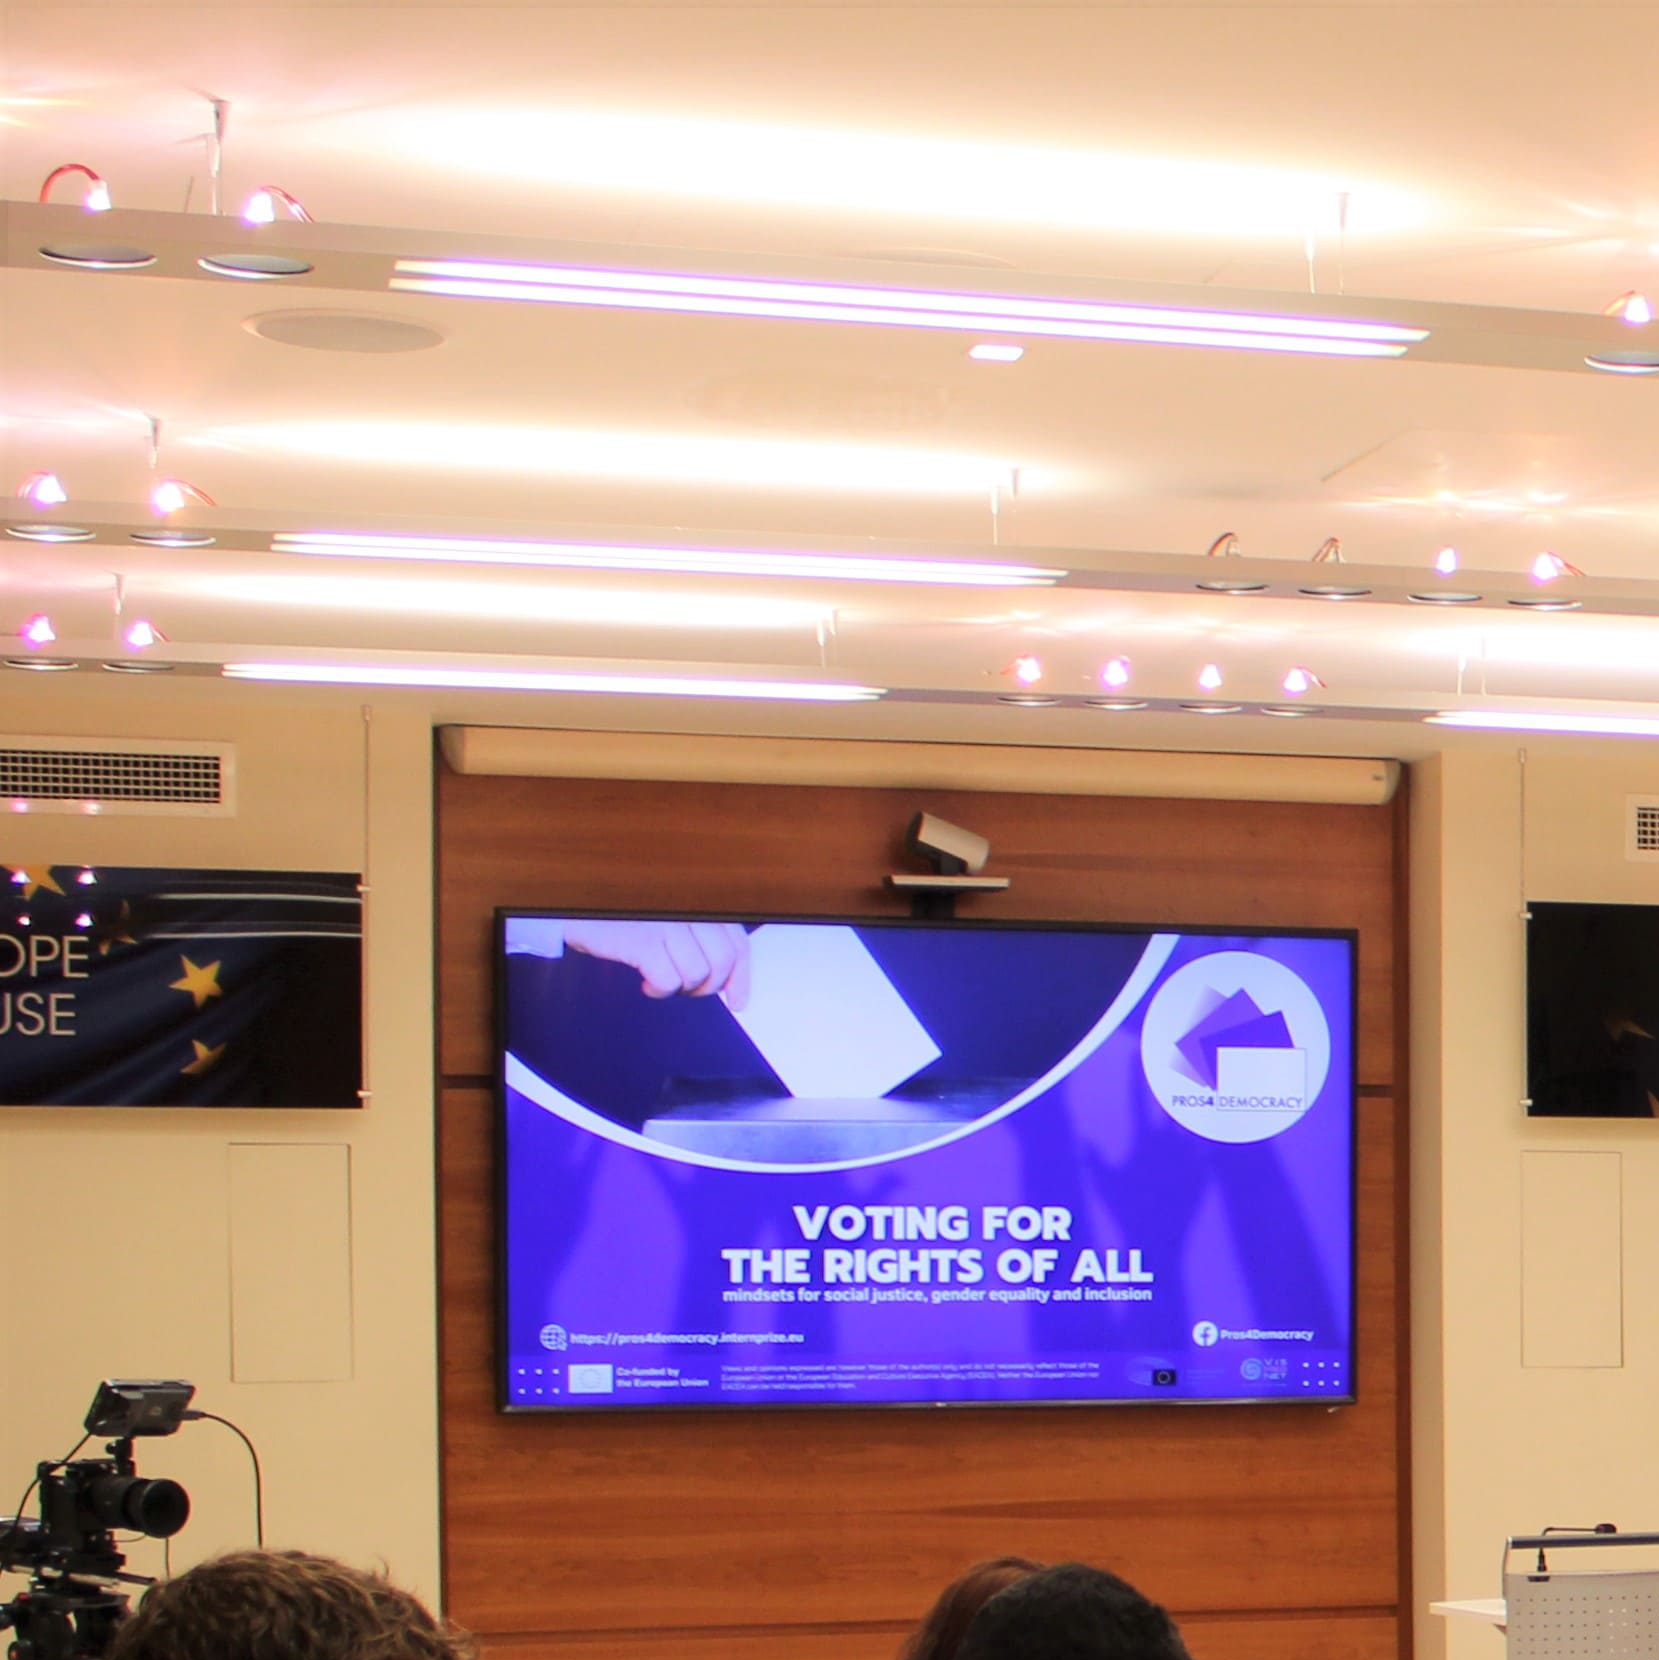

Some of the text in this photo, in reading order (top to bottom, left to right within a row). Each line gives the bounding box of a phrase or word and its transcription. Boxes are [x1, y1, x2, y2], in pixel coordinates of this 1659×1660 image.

[1172, 1095, 1303, 1108] PROS4 DEMOCRACY
[793, 1205, 1072, 1240] VOTING FOR
[721, 1248, 1154, 1284] THE RIGHTS OF ALL
[722, 1287, 1153, 1304] mindsets for social justice, gender equality and inclusion
[1220, 1329, 1315, 1341] Pros4Democracy
[633, 1377, 678, 1389] European
[680, 1377, 710, 1388] Union
